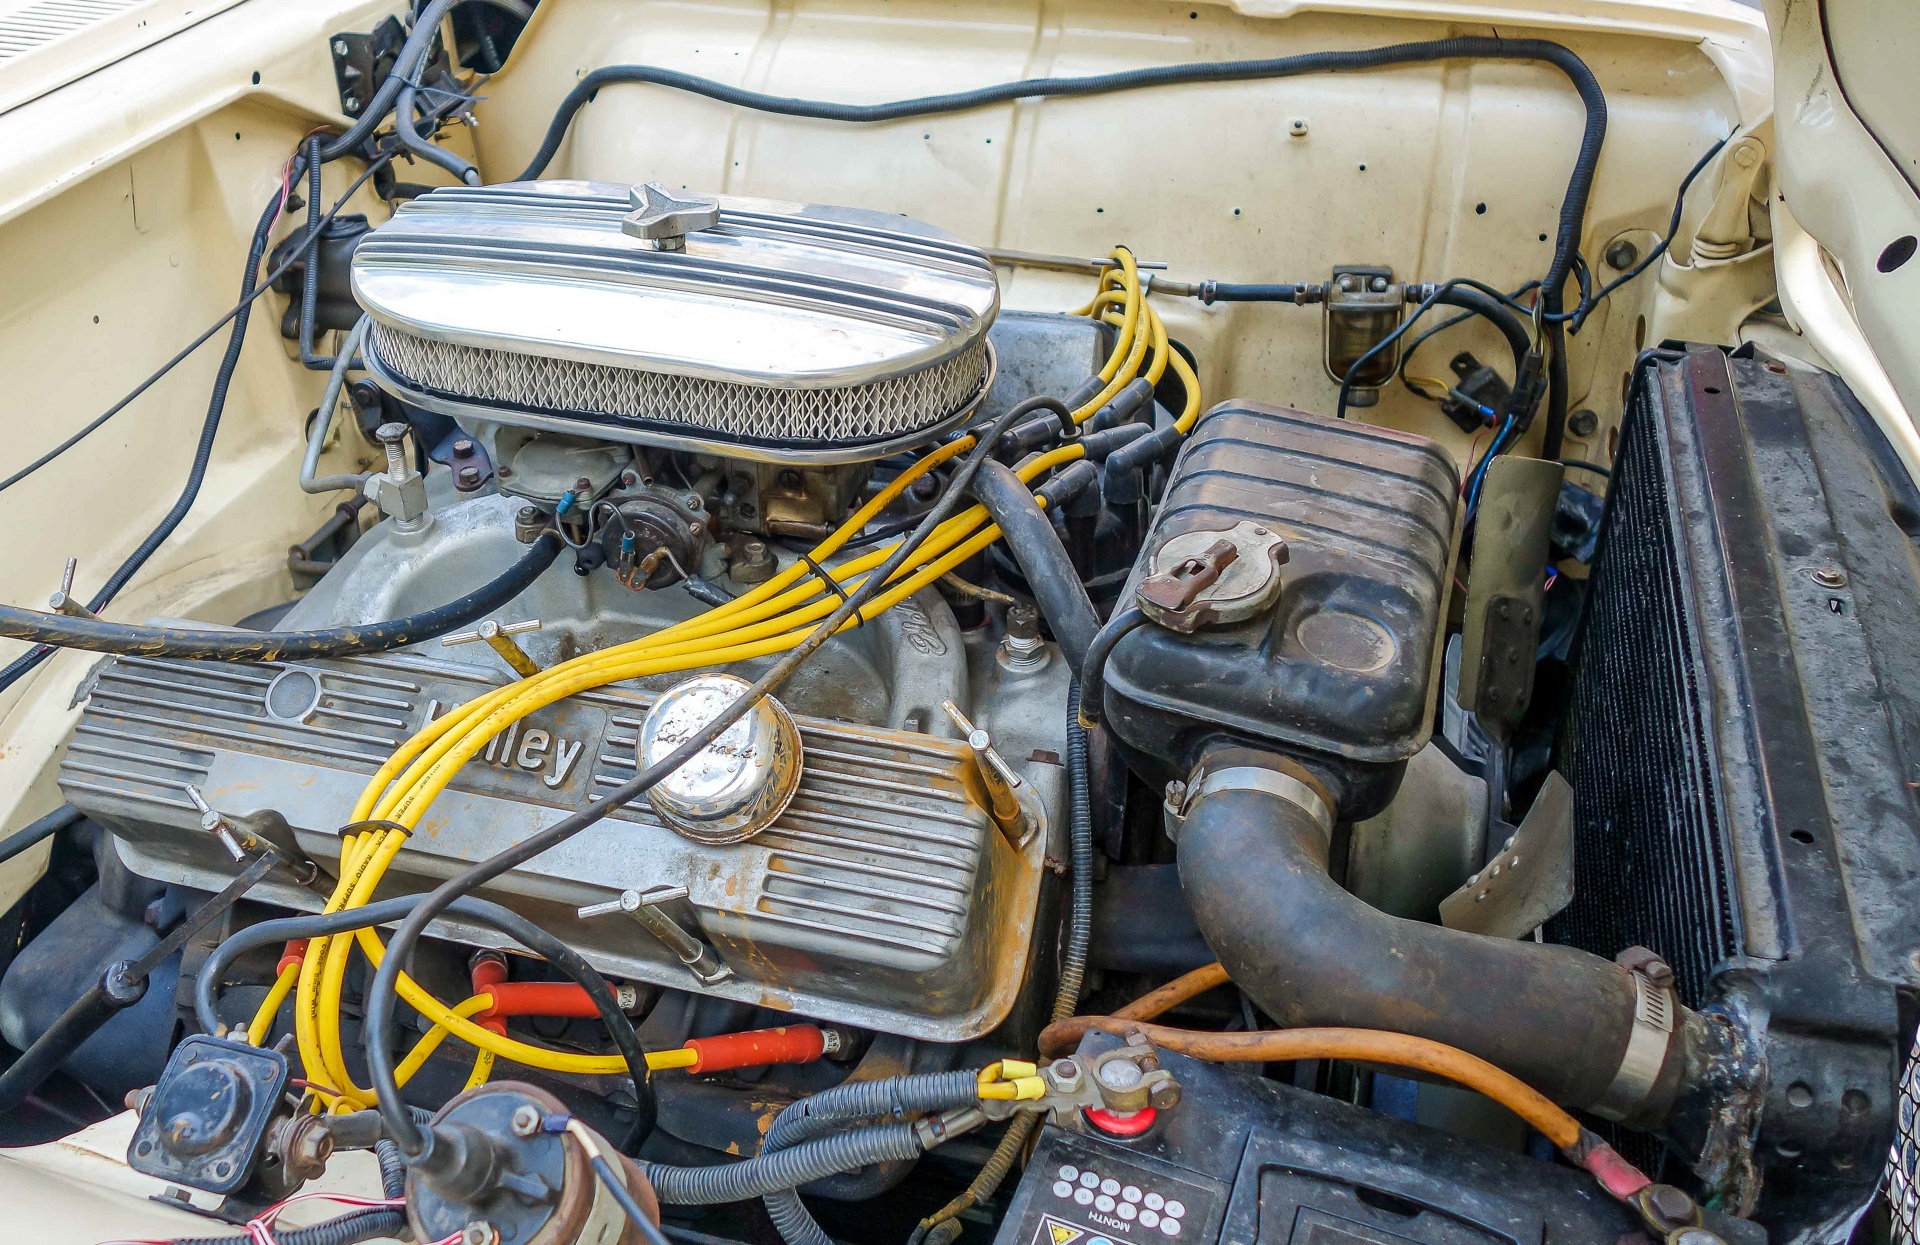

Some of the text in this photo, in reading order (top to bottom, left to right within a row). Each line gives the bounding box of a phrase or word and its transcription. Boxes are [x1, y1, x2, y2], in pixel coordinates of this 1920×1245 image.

[395, 796, 415, 819] SUPER
[355, 854, 373, 879] RADIO
[1088, 1210, 1131, 1233] MONTH
